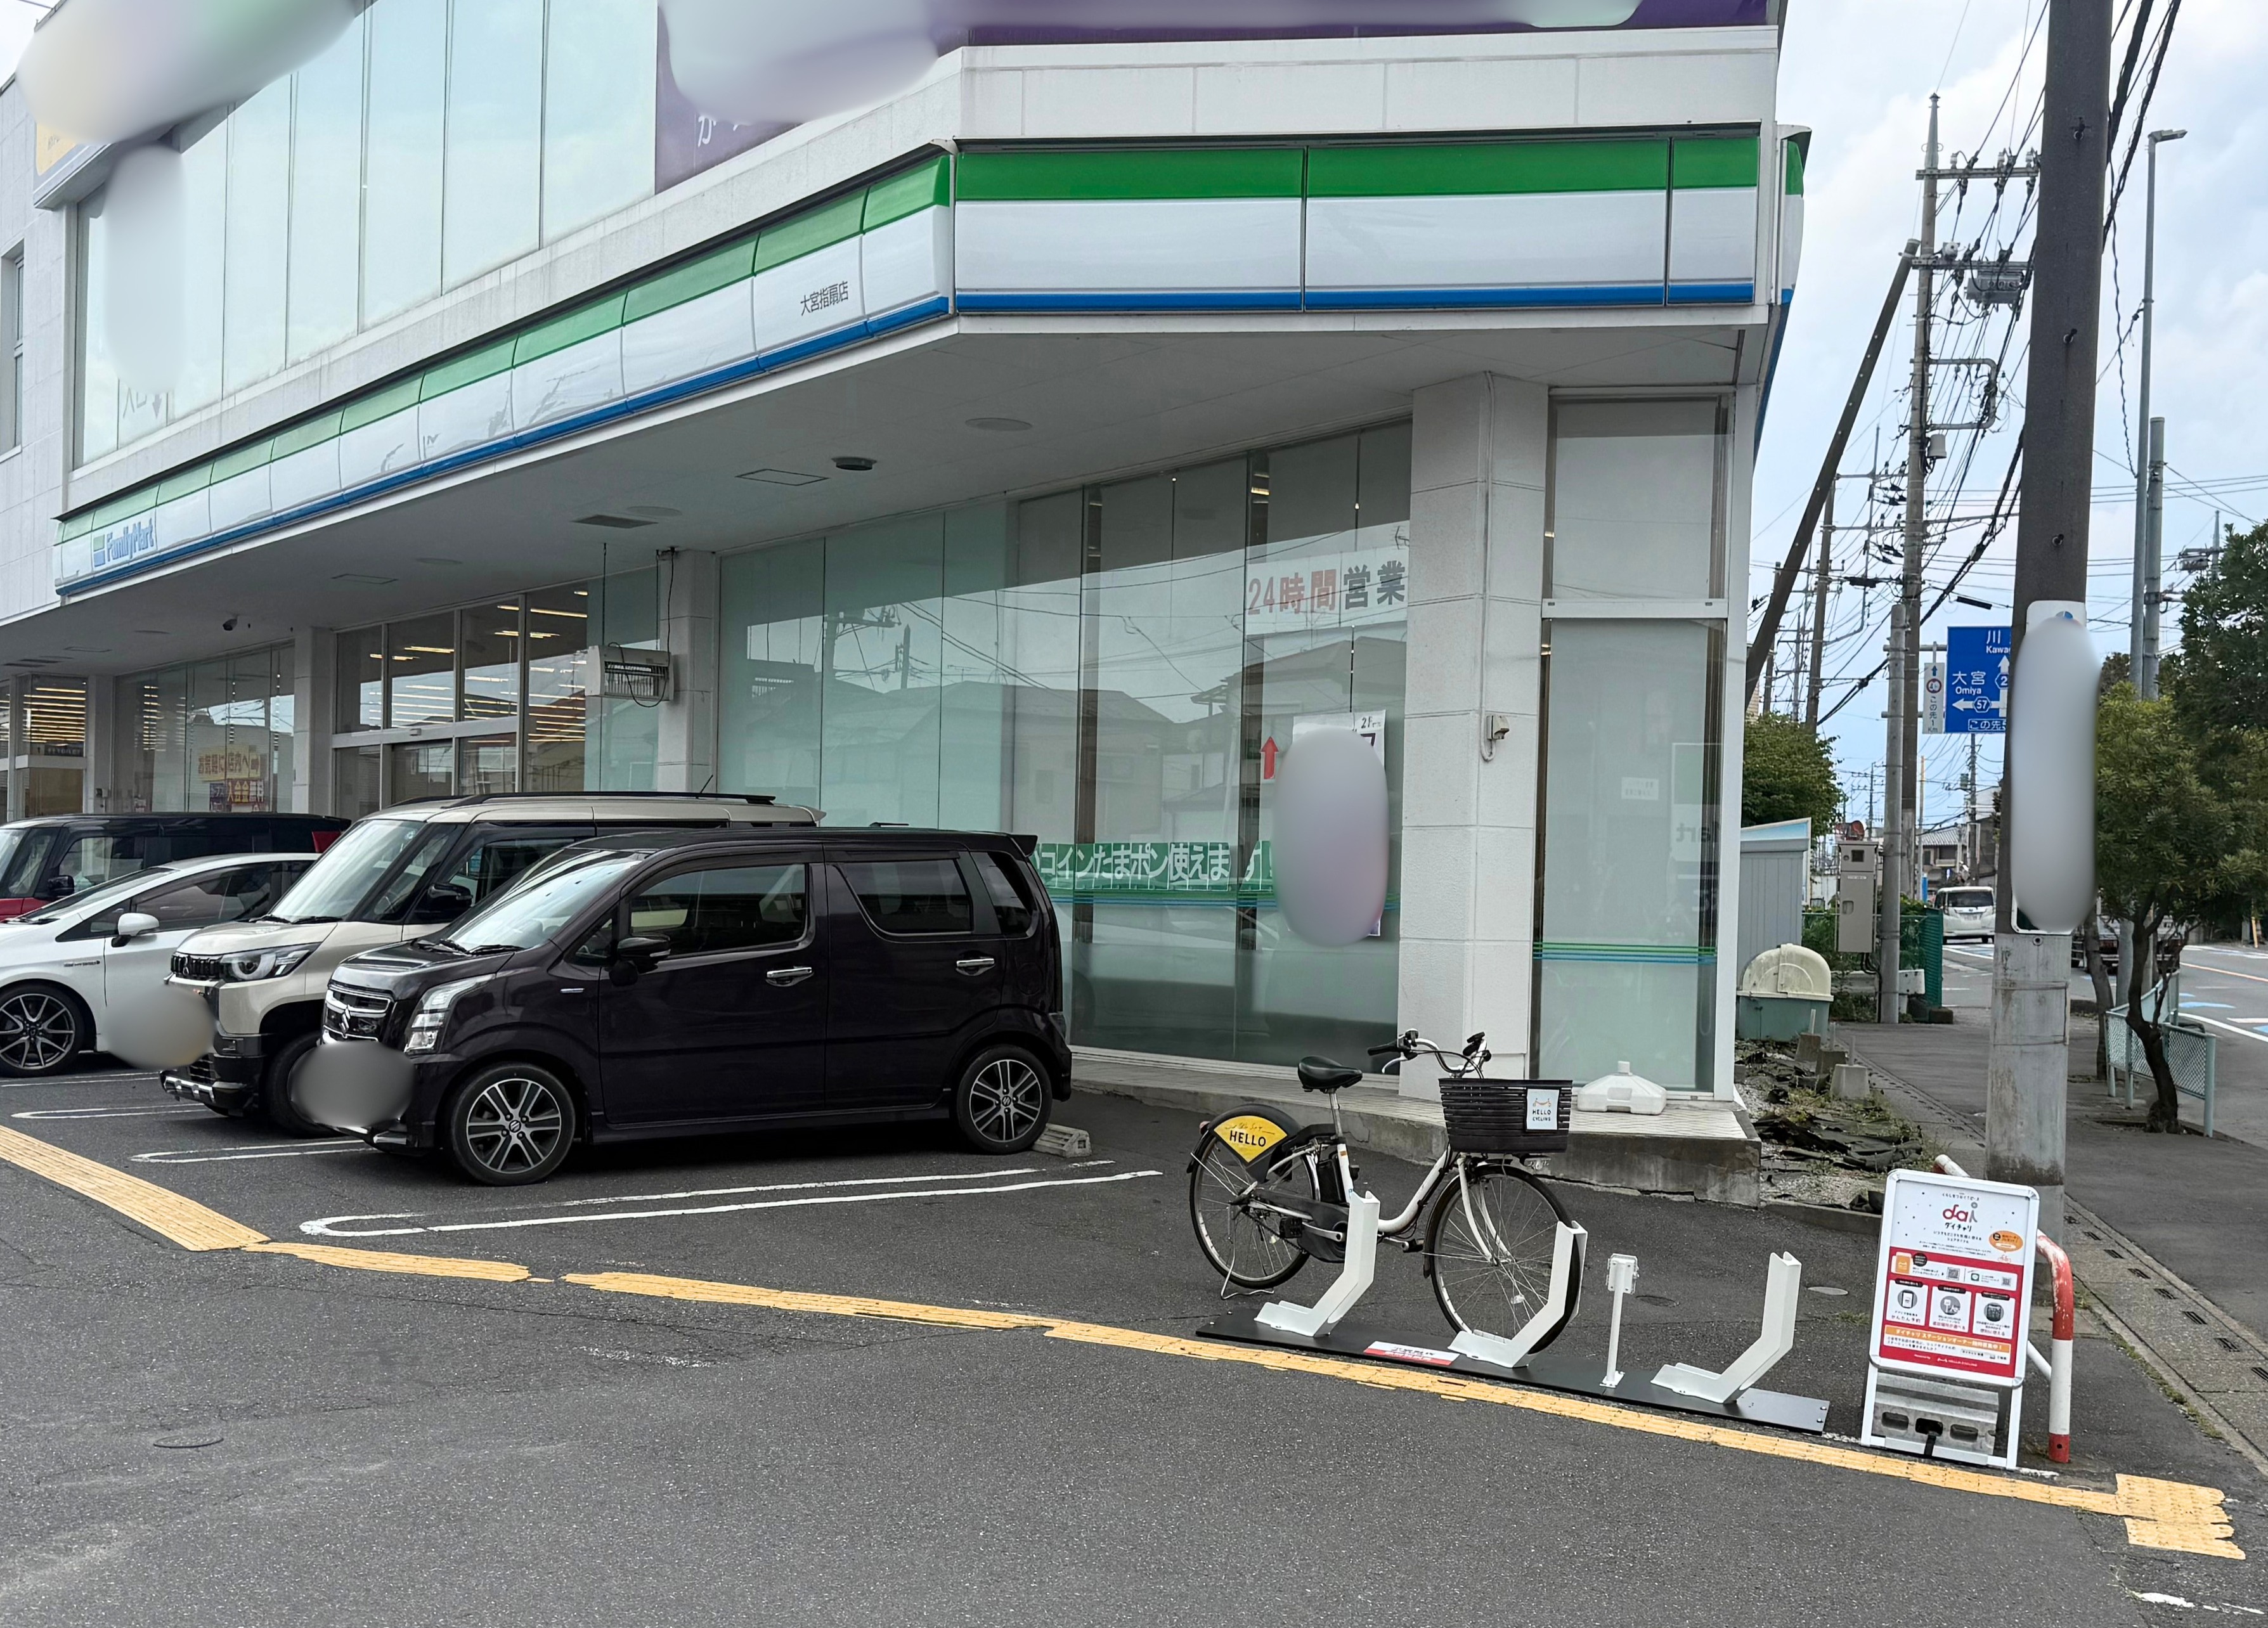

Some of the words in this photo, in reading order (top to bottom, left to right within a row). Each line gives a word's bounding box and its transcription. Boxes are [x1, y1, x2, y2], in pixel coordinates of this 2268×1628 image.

[800, 280, 848, 316] 大宮指扇店
[106, 517, 154, 562] FamilyMart
[1248, 560, 1406, 615] 24時間営業
[1952, 671, 1986, 685] 大宮
[1955, 687, 1982, 695] Omiya
[1976, 700, 1987, 709] 57
[1229, 1130, 1266, 1147] HELLO
